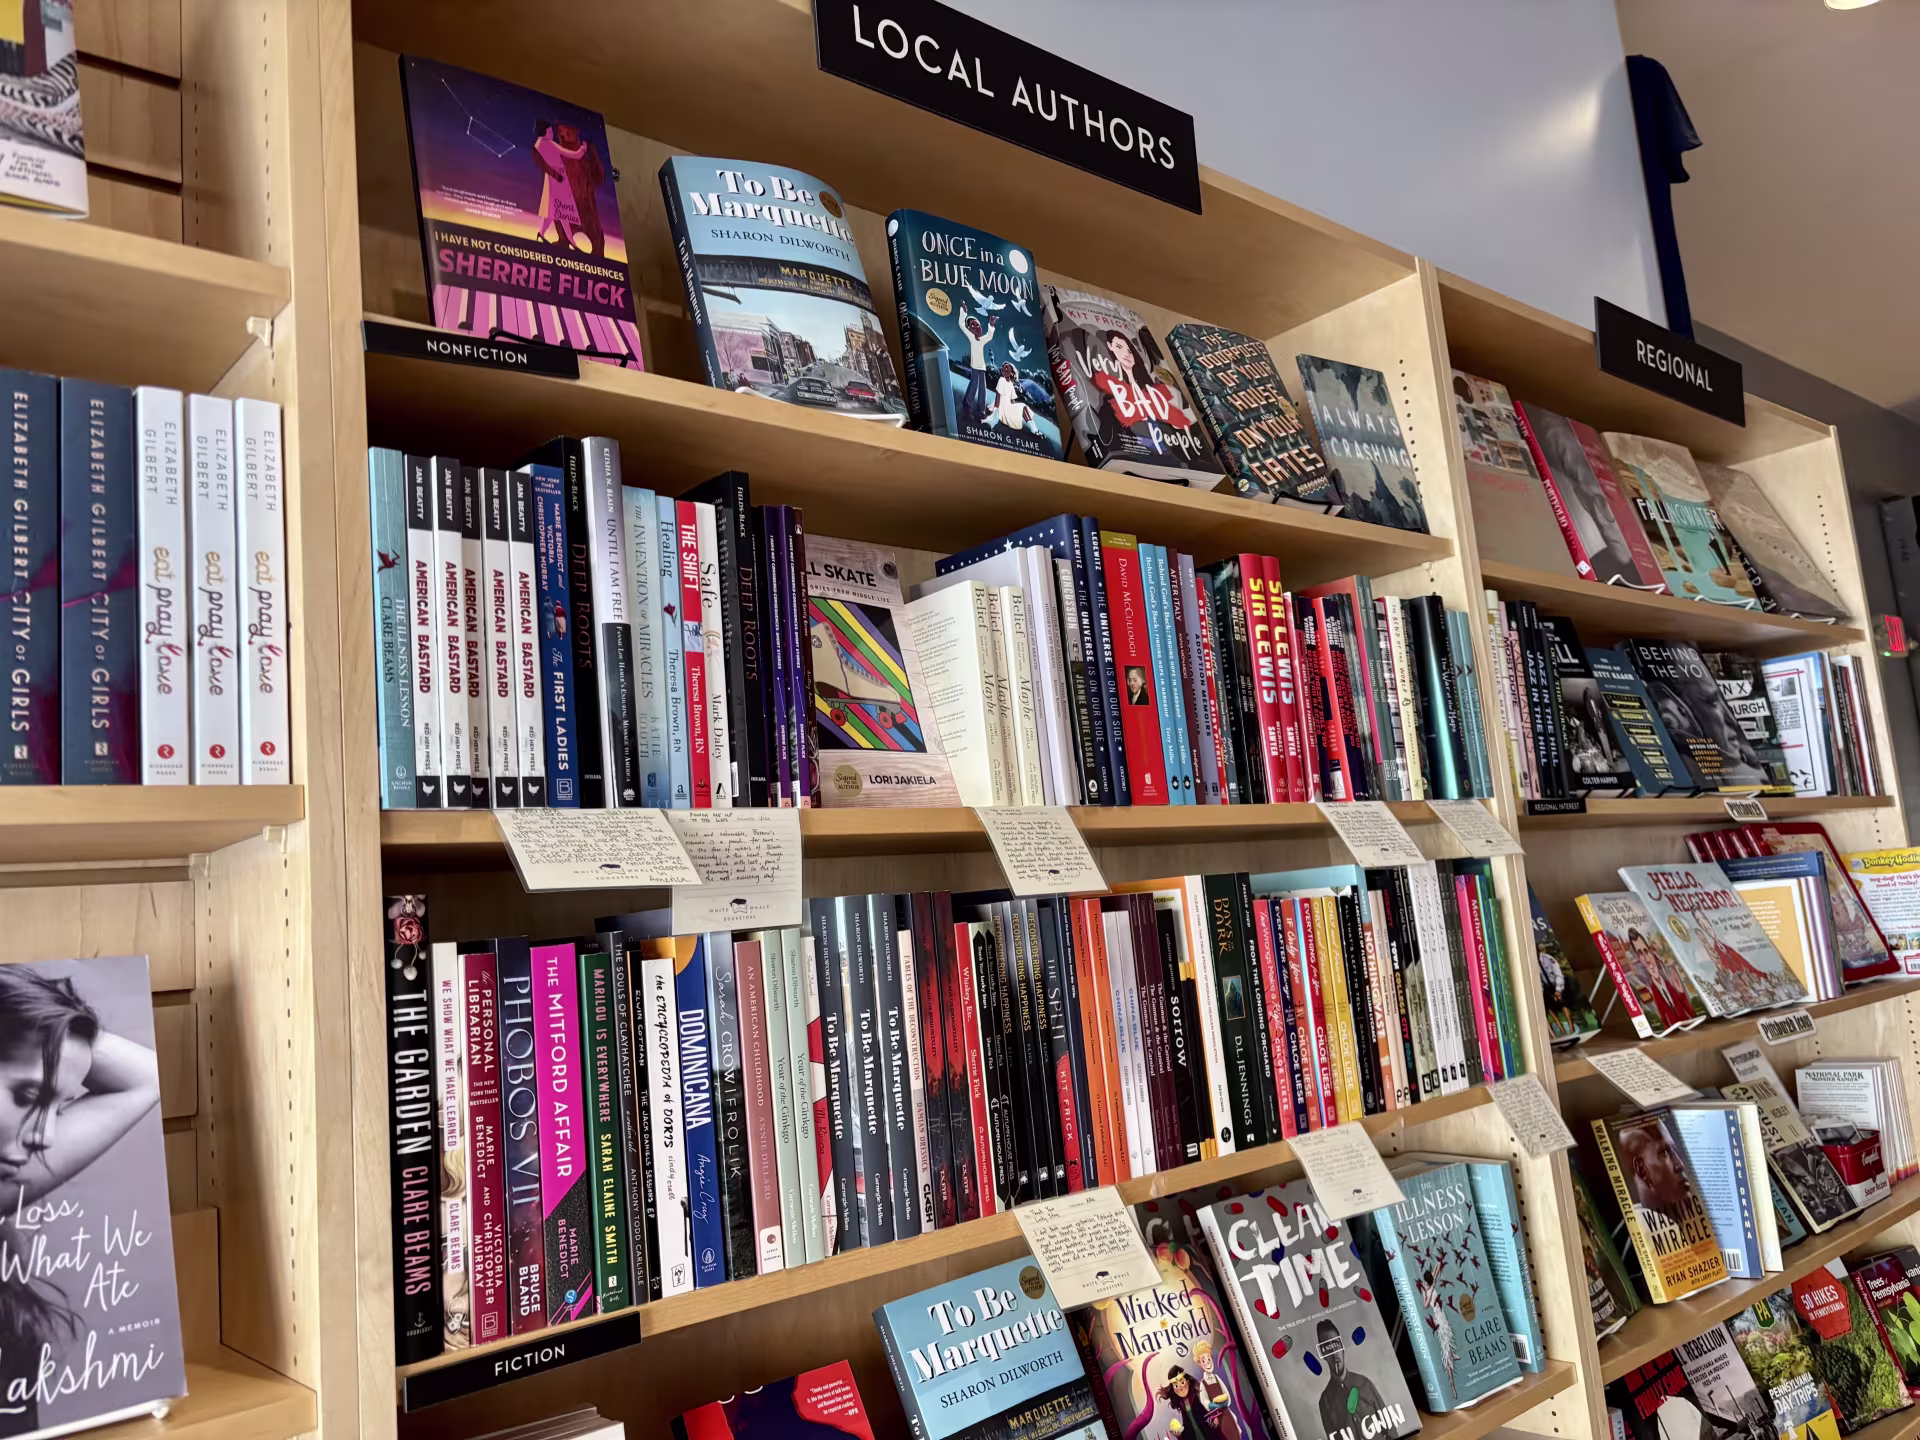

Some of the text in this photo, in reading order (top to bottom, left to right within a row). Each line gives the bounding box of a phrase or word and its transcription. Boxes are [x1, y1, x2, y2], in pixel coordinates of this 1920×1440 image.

[852, 4, 1175, 170] LOCAL AUTHORS
[554, 199, 575, 212] Short
[716, 170, 815, 206] To Be
[554, 210, 580, 223] Stories
[689, 192, 855, 248] Marquette
[435, 231, 624, 281] I HAVE NOT CONSIDERED CONSEQUENCES
[711, 229, 851, 262] SHARON DILWORTH
[922, 230, 1005, 265] ONCE in a
[439, 248, 626, 309] SHERRIE FLICK
[920, 259, 1034, 301] BLUE MOON
[1068, 310, 1130, 330] KIT FRICK
[1200, 332, 1227, 346] THE
[427, 340, 528, 364] NONFICTION
[1076, 346, 1124, 380] Very
[1196, 342, 1268, 370] DOORPOSTS
[1216, 361, 1275, 387] OF YOUR
[1636, 339, 1713, 392] REGIONAL
[1107, 380, 1169, 421] BAD
[1227, 384, 1284, 412] HOUSE
[1322, 405, 1399, 436] ALWAYS
[966, 426, 1040, 451] SHARON G. FLAKE
[1233, 423, 1266, 449] ON
[1330, 437, 1411, 468] CRASHING
[13, 391, 29, 579] ELIZABETH GILBERT
[144, 429, 158, 494] GILBERT
[164, 421, 178, 505] ELIZABETH
[1250, 445, 1326, 487] GATES
[1543, 478, 1569, 528] PORTFOLIO
[1636, 497, 1725, 532] FALLINGWATER
[607, 518, 619, 557] UNTIL
[660, 520, 675, 579] Healing
[681, 523, 699, 591] THE SHIFT
[1091, 530, 1102, 571] LEDEWITZ
[610, 567, 620, 590] AM
[700, 561, 718, 610] Safe
[824, 563, 877, 588] SKATE
[1061, 568, 1075, 630] CONCUSSION
[11, 592, 32, 639] CITY
[144, 546, 184, 696] eat pray love
[415, 559, 431, 694] AMERICAN BASTARD
[612, 591, 623, 621] FREE
[974, 586, 996, 717] Belief Maybe
[1100, 612, 1113, 664] UNIVERSE
[1249, 576, 1277, 706] SIR LEWIS
[1639, 646, 1700, 661] BEHIND
[1648, 664, 1679, 678] THE
[11, 668, 30, 732] GIRLS
[553, 671, 570, 771] FIRST LADIES
[1537, 651, 1559, 768] JAZZ IN THE HILL
[712, 693, 722, 761] Mark Daley
[1267, 726, 1278, 758] SAWYER
[869, 774, 936, 786] LORI JAKIELA
[1534, 802, 1579, 811] REGIONAL INTEREST
[1647, 872, 1703, 901] HELLO,
[1471, 899, 1489, 991] Mother Country
[1364, 931, 1385, 1037] NOTHING VAST
[593, 968, 611, 1124] MARILOU IS EVERYWHERE
[1171, 996, 1187, 1067] sorrow
[393, 989, 432, 1155] THE GARDEN
[503, 974, 541, 1206] PHOBOS VII
[545, 956, 573, 1179] THE MITFORD AFFAIR
[679, 1008, 712, 1131] DOMINICANA
[1235, 1035, 1252, 1125] D.L. JENNINGS
[1060, 1070, 1073, 1141] KIT FRICK
[600, 1133, 618, 1265] SARAH ELAINE SMITH
[1395, 1183, 1467, 1224] ILLNESS
[1730, 1126, 1753, 1240] PLUME DRAMA
[15, 1185, 84, 1230] Loss,
[402, 1165, 431, 1296] CLARE BEAMS
[1407, 1210, 1466, 1243] LESSON
[1642, 1196, 1704, 1233] WALKING
[1, 1209, 152, 1284] What We
[1651, 1218, 1712, 1257] MIRACLE
[83, 1261, 139, 1312] Ate
[1239, 1241, 1361, 1319] TIME
[1666, 1256, 1721, 1288] RYAN SHAZIER
[927, 1285, 1020, 1336] To Be
[1115, 1280, 1193, 1327] Wicked
[1801, 1285, 1839, 1310] 50 HIKES
[118, 1318, 161, 1333] MEMOIR
[907, 1308, 1064, 1386] Marquette
[1114, 1308, 1212, 1358] Marigold
[1464, 1316, 1502, 1344] CLARE
[0, 1330, 164, 1413] akshmi
[495, 1344, 566, 1377] FICTION
[1468, 1336, 1507, 1366] BEAMS
[940, 1351, 1064, 1409] SHARON DILWORTH
[1768, 1372, 1814, 1400] PENNSYLVANIA
[1774, 1382, 1819, 1415] DAY TRIPS
